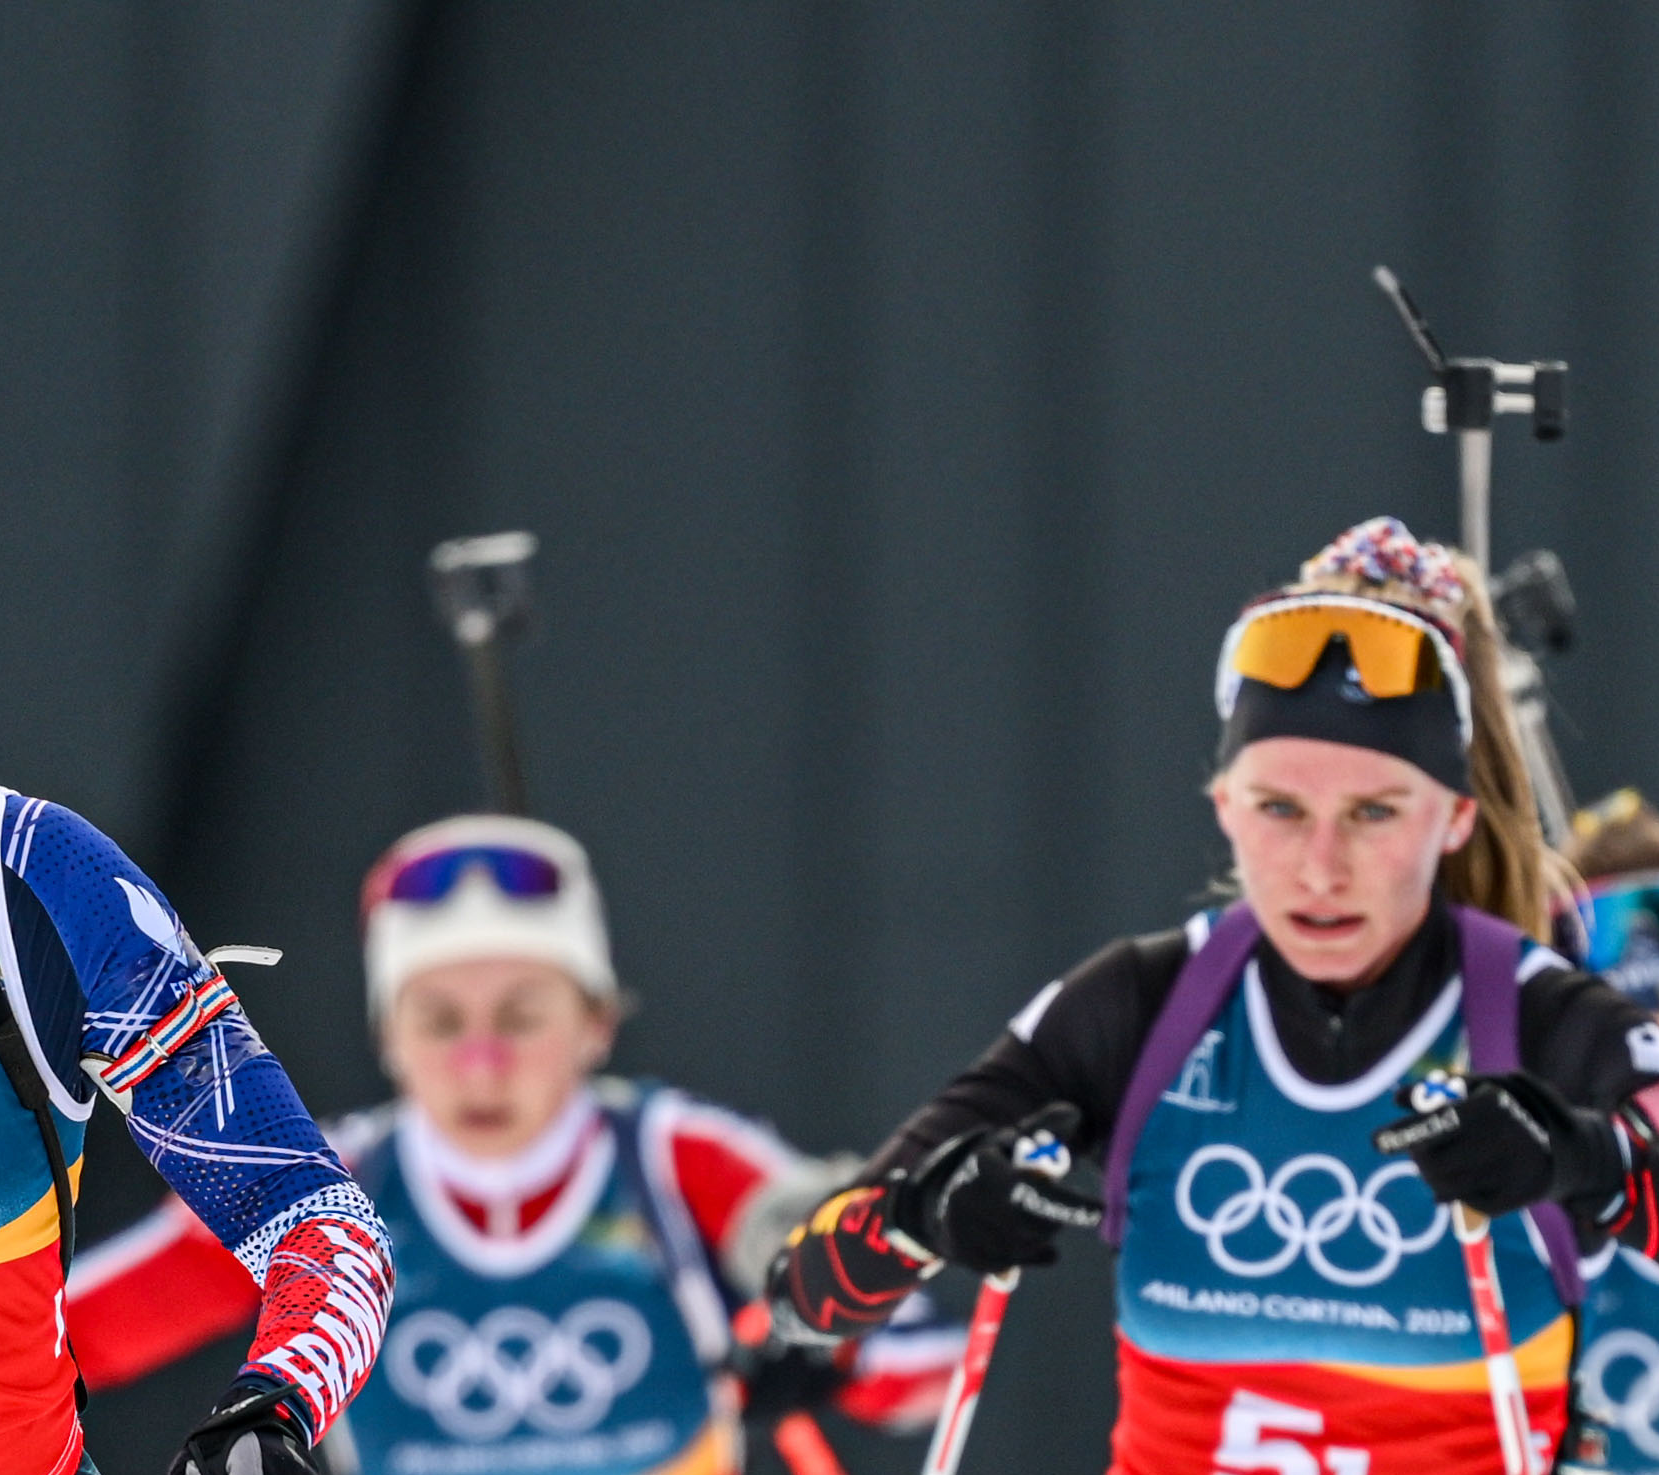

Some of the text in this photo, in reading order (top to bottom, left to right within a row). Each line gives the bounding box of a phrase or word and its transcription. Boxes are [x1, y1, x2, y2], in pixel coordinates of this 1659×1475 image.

[1142, 1281, 1471, 1334] MILANO CORTINA 2026
